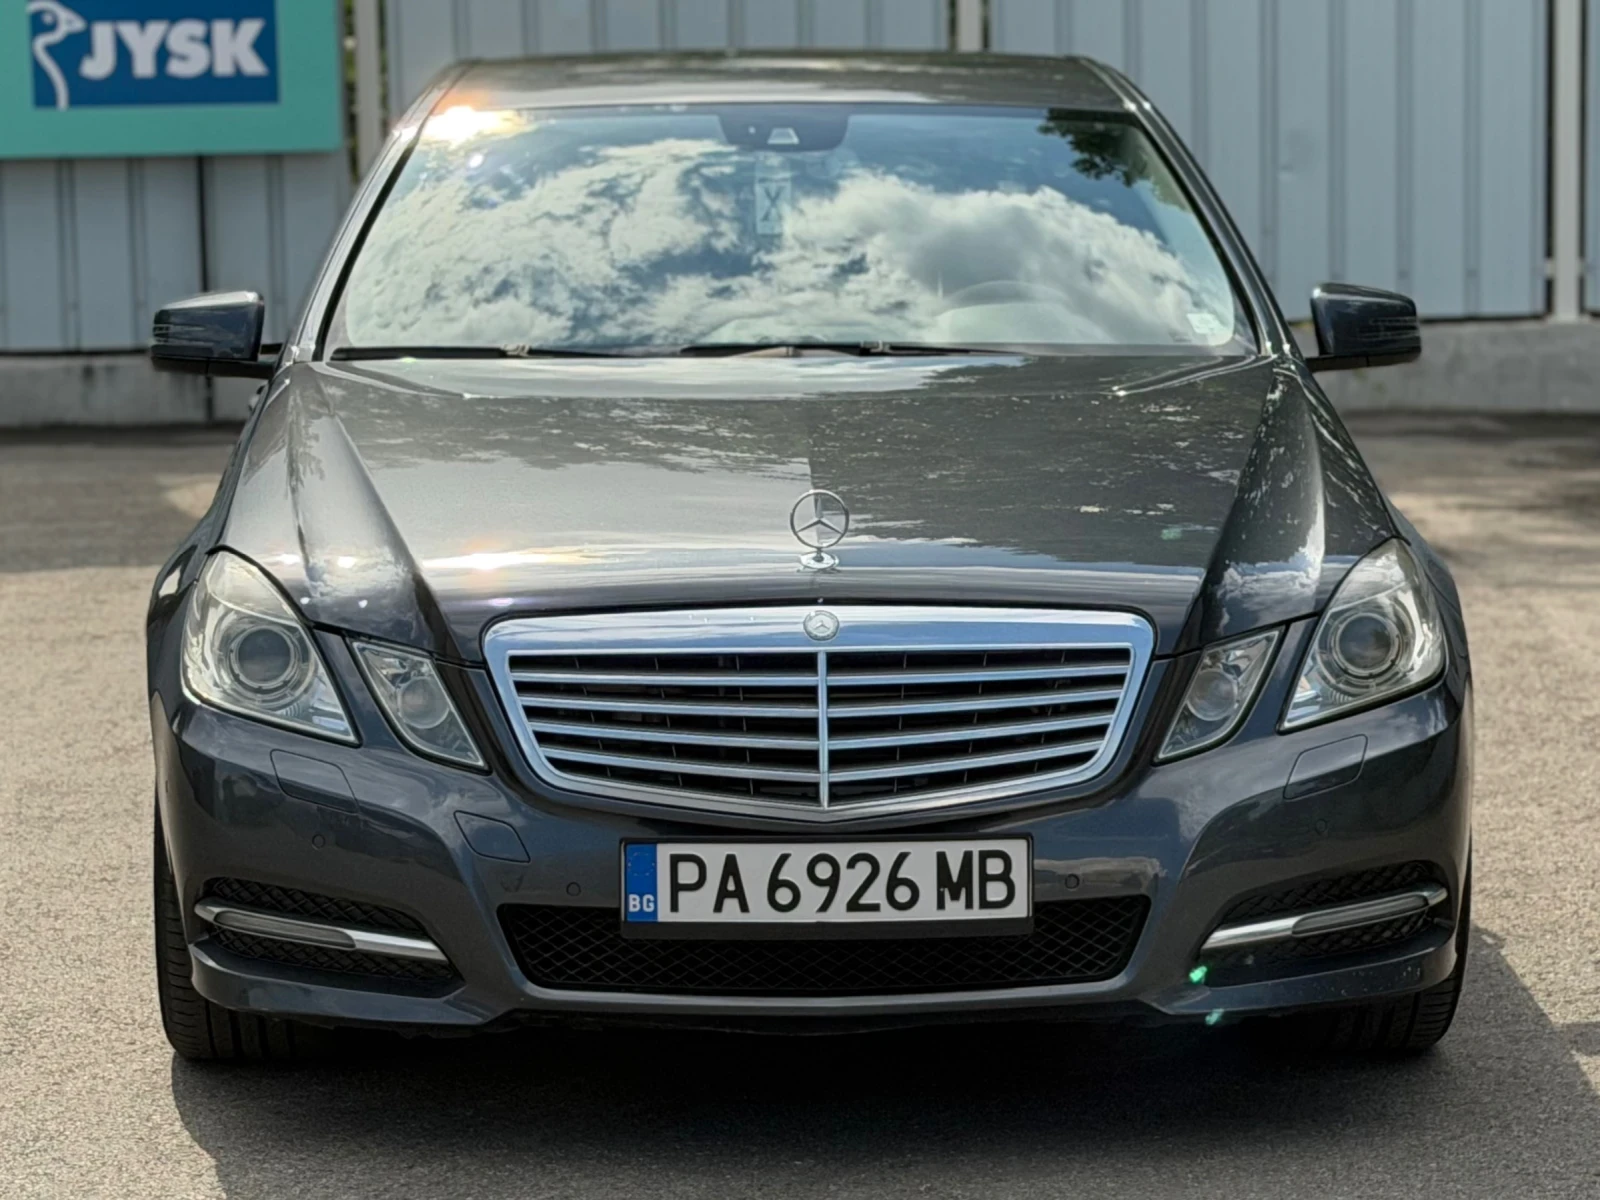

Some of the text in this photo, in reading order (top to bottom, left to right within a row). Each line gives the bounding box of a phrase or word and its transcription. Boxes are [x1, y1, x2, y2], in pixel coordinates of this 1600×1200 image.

[79, 18, 269, 80] JYSK
[628, 895, 655, 912] BG
[669, 850, 1017, 913] PA 6926 MB
